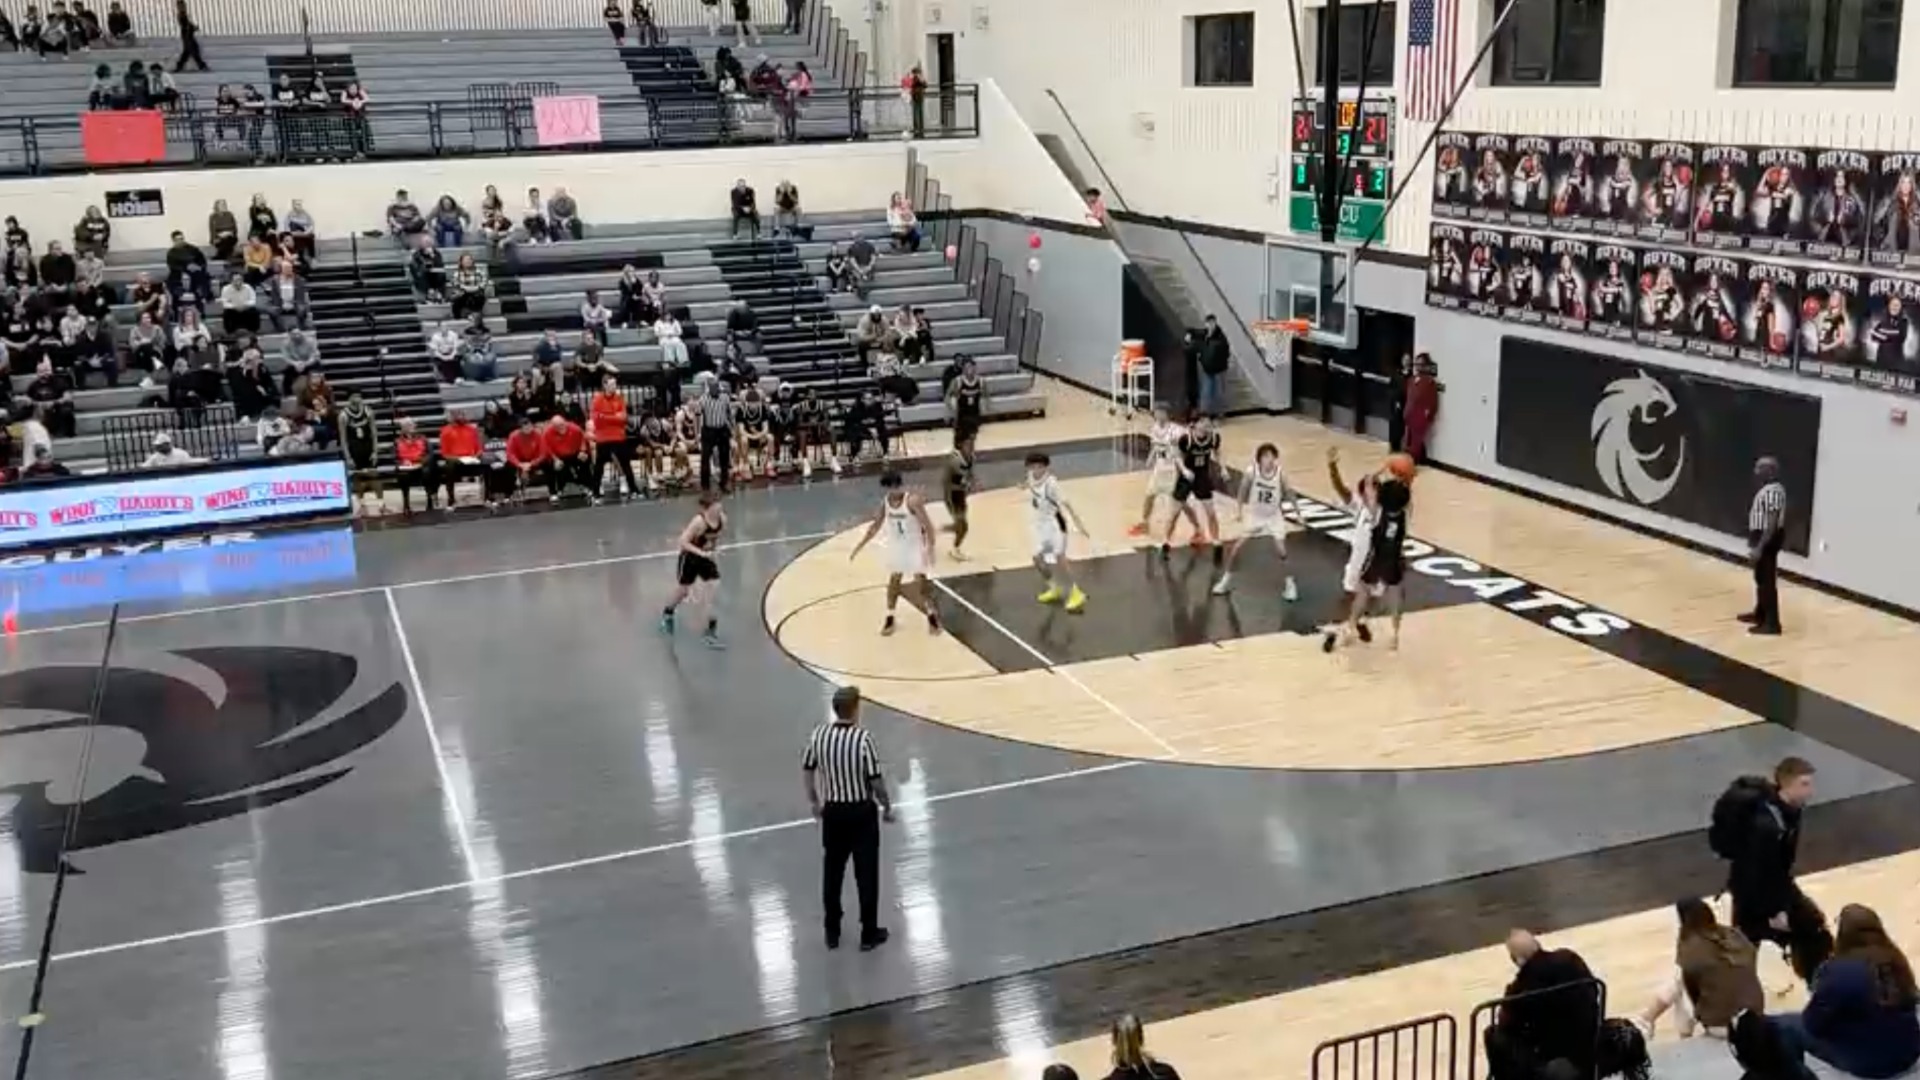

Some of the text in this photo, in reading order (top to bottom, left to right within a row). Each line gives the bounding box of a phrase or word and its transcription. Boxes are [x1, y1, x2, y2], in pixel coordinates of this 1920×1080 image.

[1366, 116, 1386, 143] 21
[1703, 146, 1748, 167] GUYER
[1757, 148, 1806, 169] GUYER
[1817, 151, 1870, 174] GUYER
[109, 200, 161, 217] HOME
[1694, 255, 1739, 279] GUYER
[1748, 263, 1796, 288] GUYER
[1806, 270, 1860, 297] GUYER
[1259, 490, 1273, 503] 12
[0, 510, 38, 527] DY'S
[1280, 498, 1631, 636] WICATS
